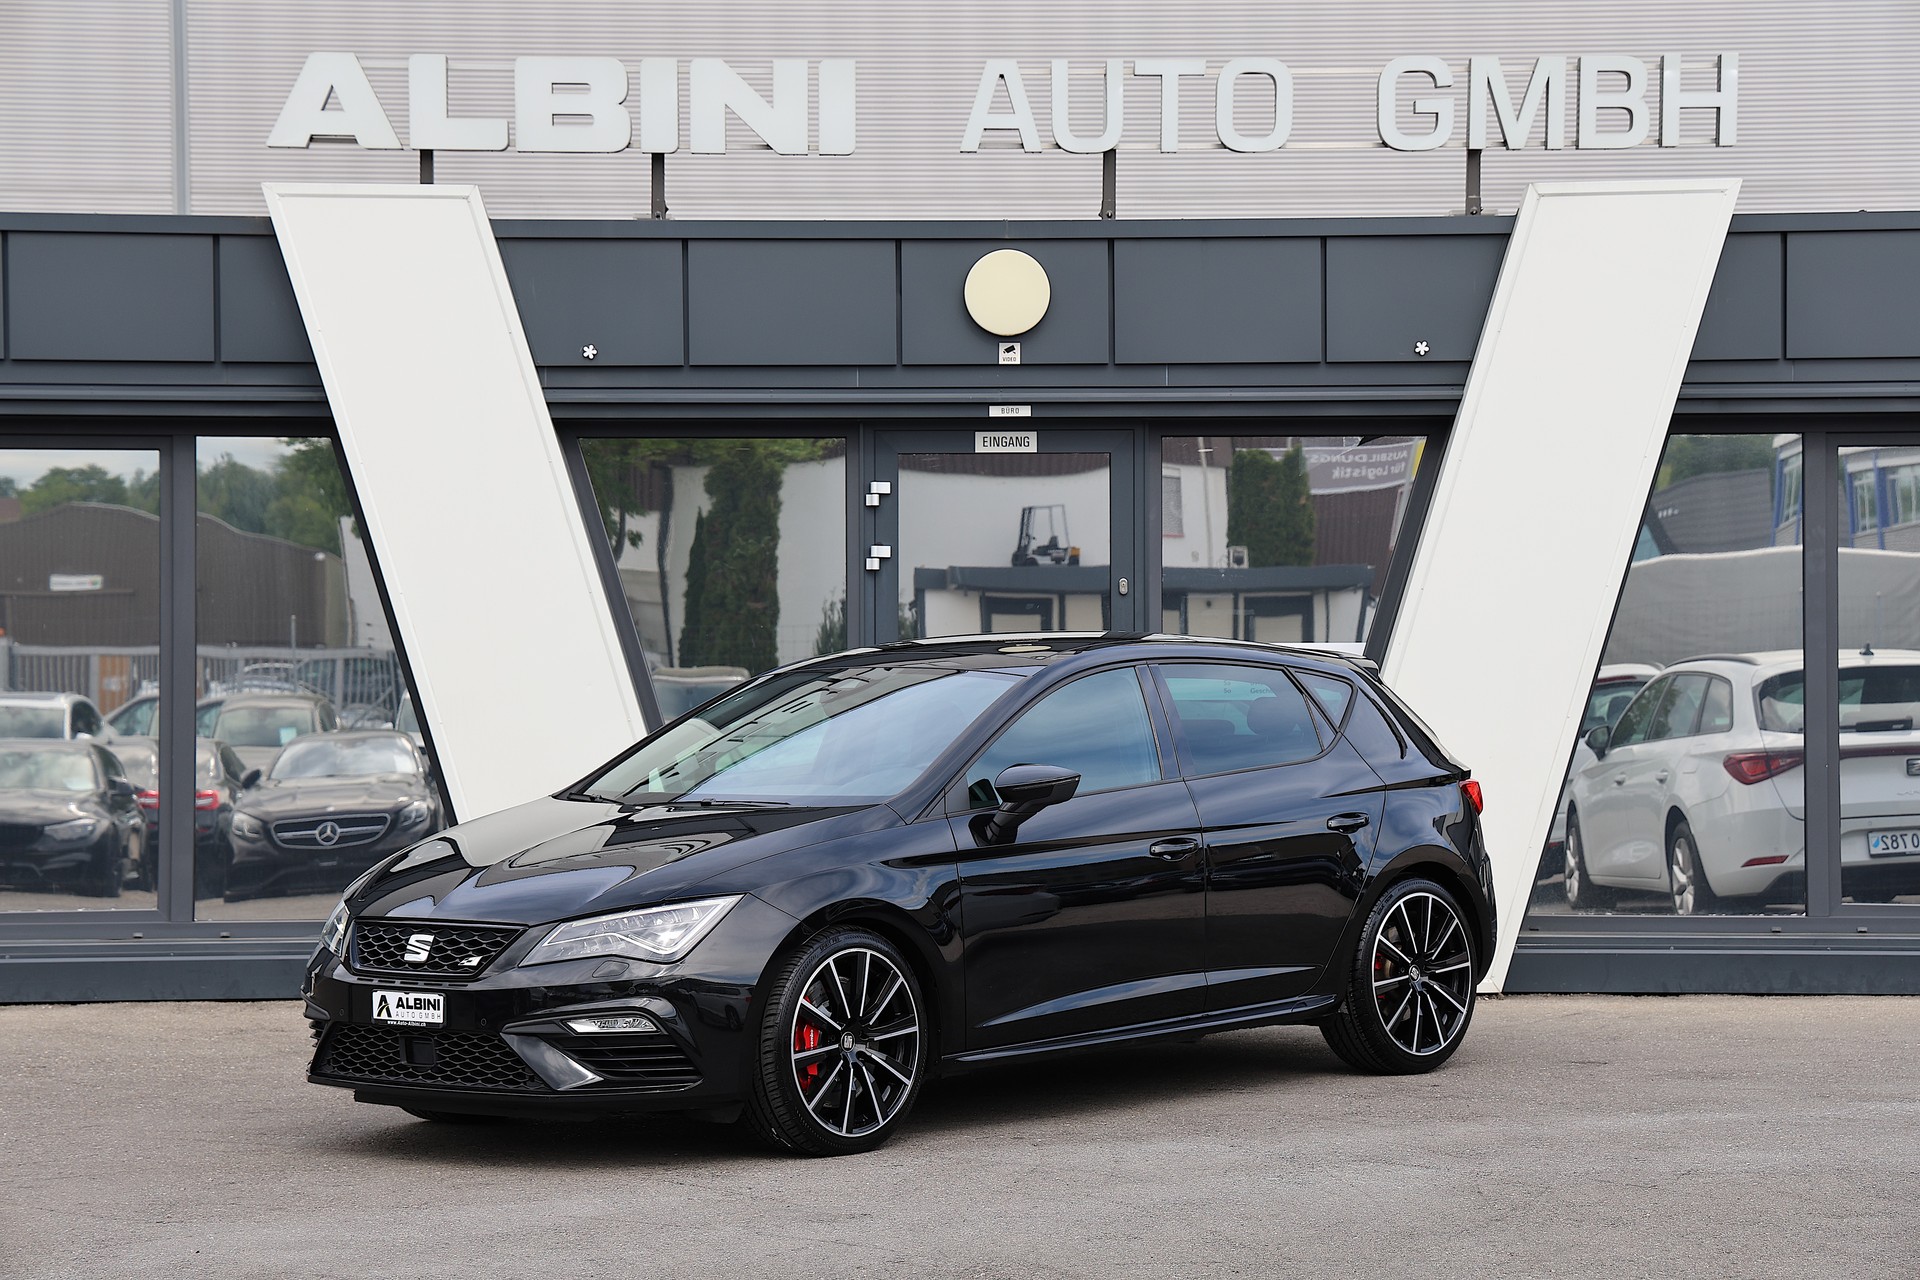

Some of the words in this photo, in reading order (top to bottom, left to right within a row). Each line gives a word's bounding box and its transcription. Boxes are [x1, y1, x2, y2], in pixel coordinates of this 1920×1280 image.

[266, 51, 857, 156] ALBINI
[960, 56, 1295, 154] AUTO
[1377, 52, 1740, 152] GMBH
[982, 436, 1030, 448] EINGANG
[396, 996, 441, 1011] ALBINI
[419, 1012, 441, 1020] GMBH
